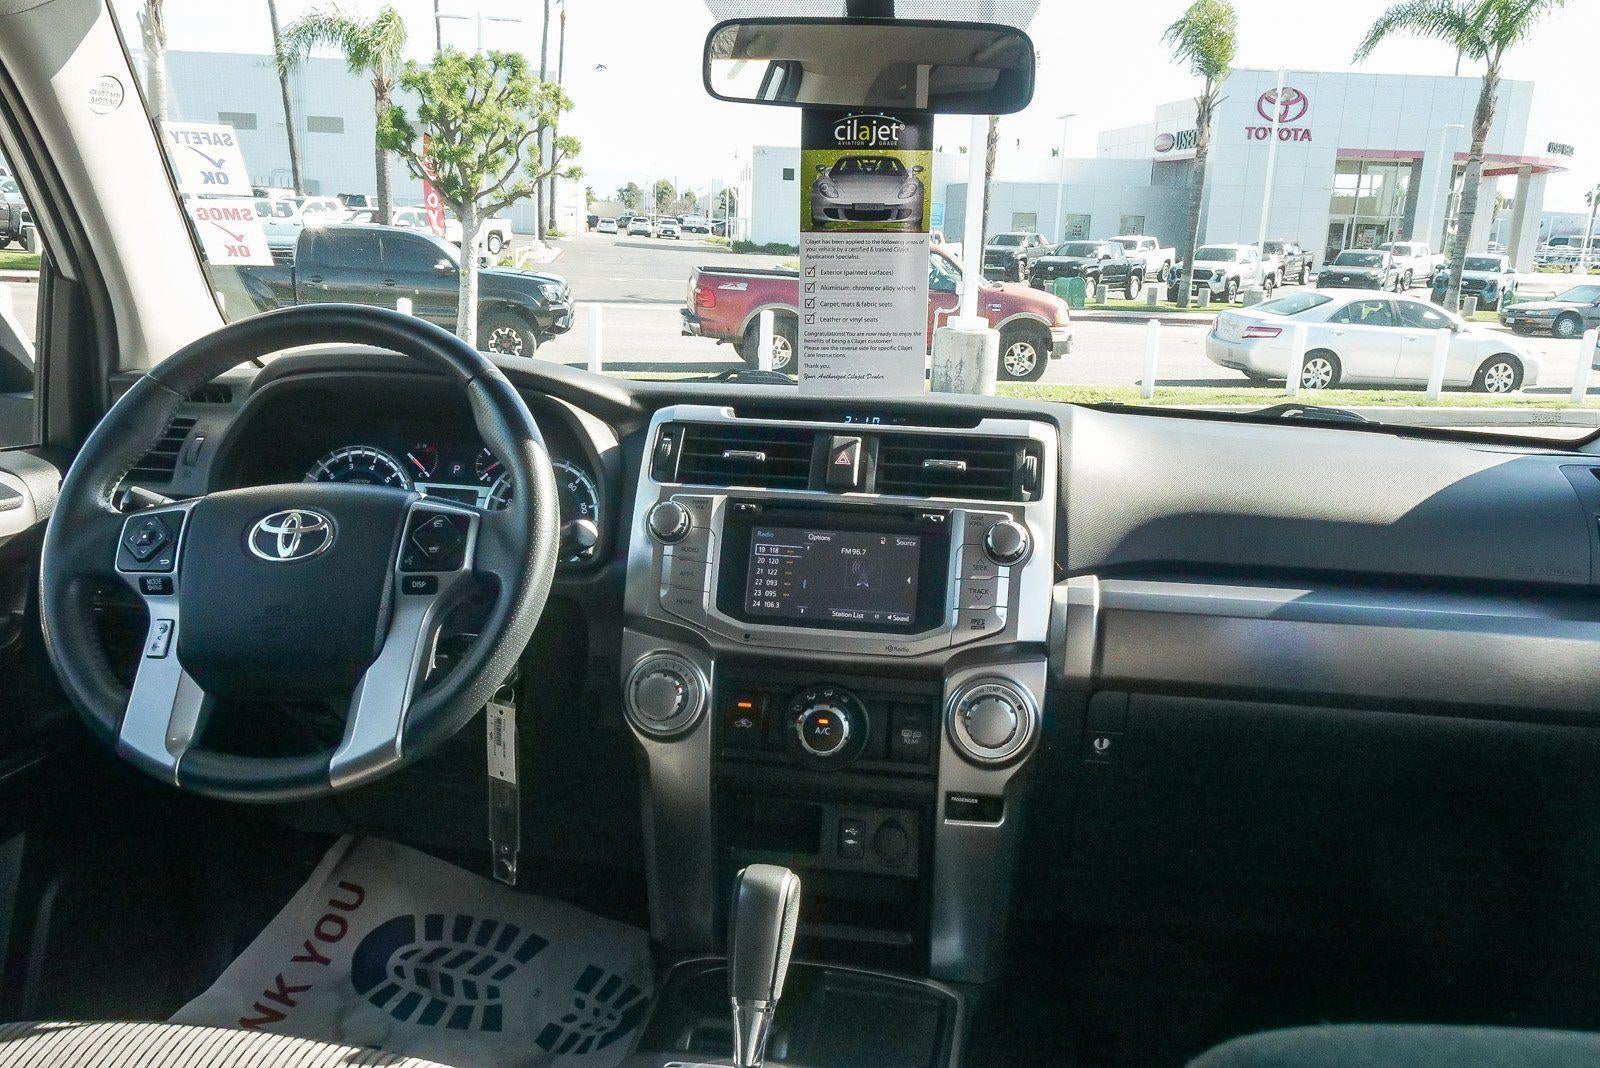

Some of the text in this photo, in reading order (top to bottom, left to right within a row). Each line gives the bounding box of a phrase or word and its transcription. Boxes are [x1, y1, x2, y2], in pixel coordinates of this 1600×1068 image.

[820, 269, 894, 277] Exterior (painted surfaces)
[820, 284, 851, 292] Aluminum,
[852, 284, 874, 292] chrome
[883, 284, 896, 292] alloy
[896, 284, 916, 292] wheels
[453, 464, 461, 474] P
[757, 530, 774, 538] Radio
[808, 533, 831, 542] Options
[896, 539, 917, 547] Source
[769, 557, 779, 565] 120
[768, 568, 778, 576] 122
[766, 579, 778, 587] 093
[753, 589, 762, 597] 23
[832, 610, 852, 619] Station
[893, 614, 910, 622] Sound
[814, 726, 830, 735] A/C
[291, 881, 365, 966] YOU
